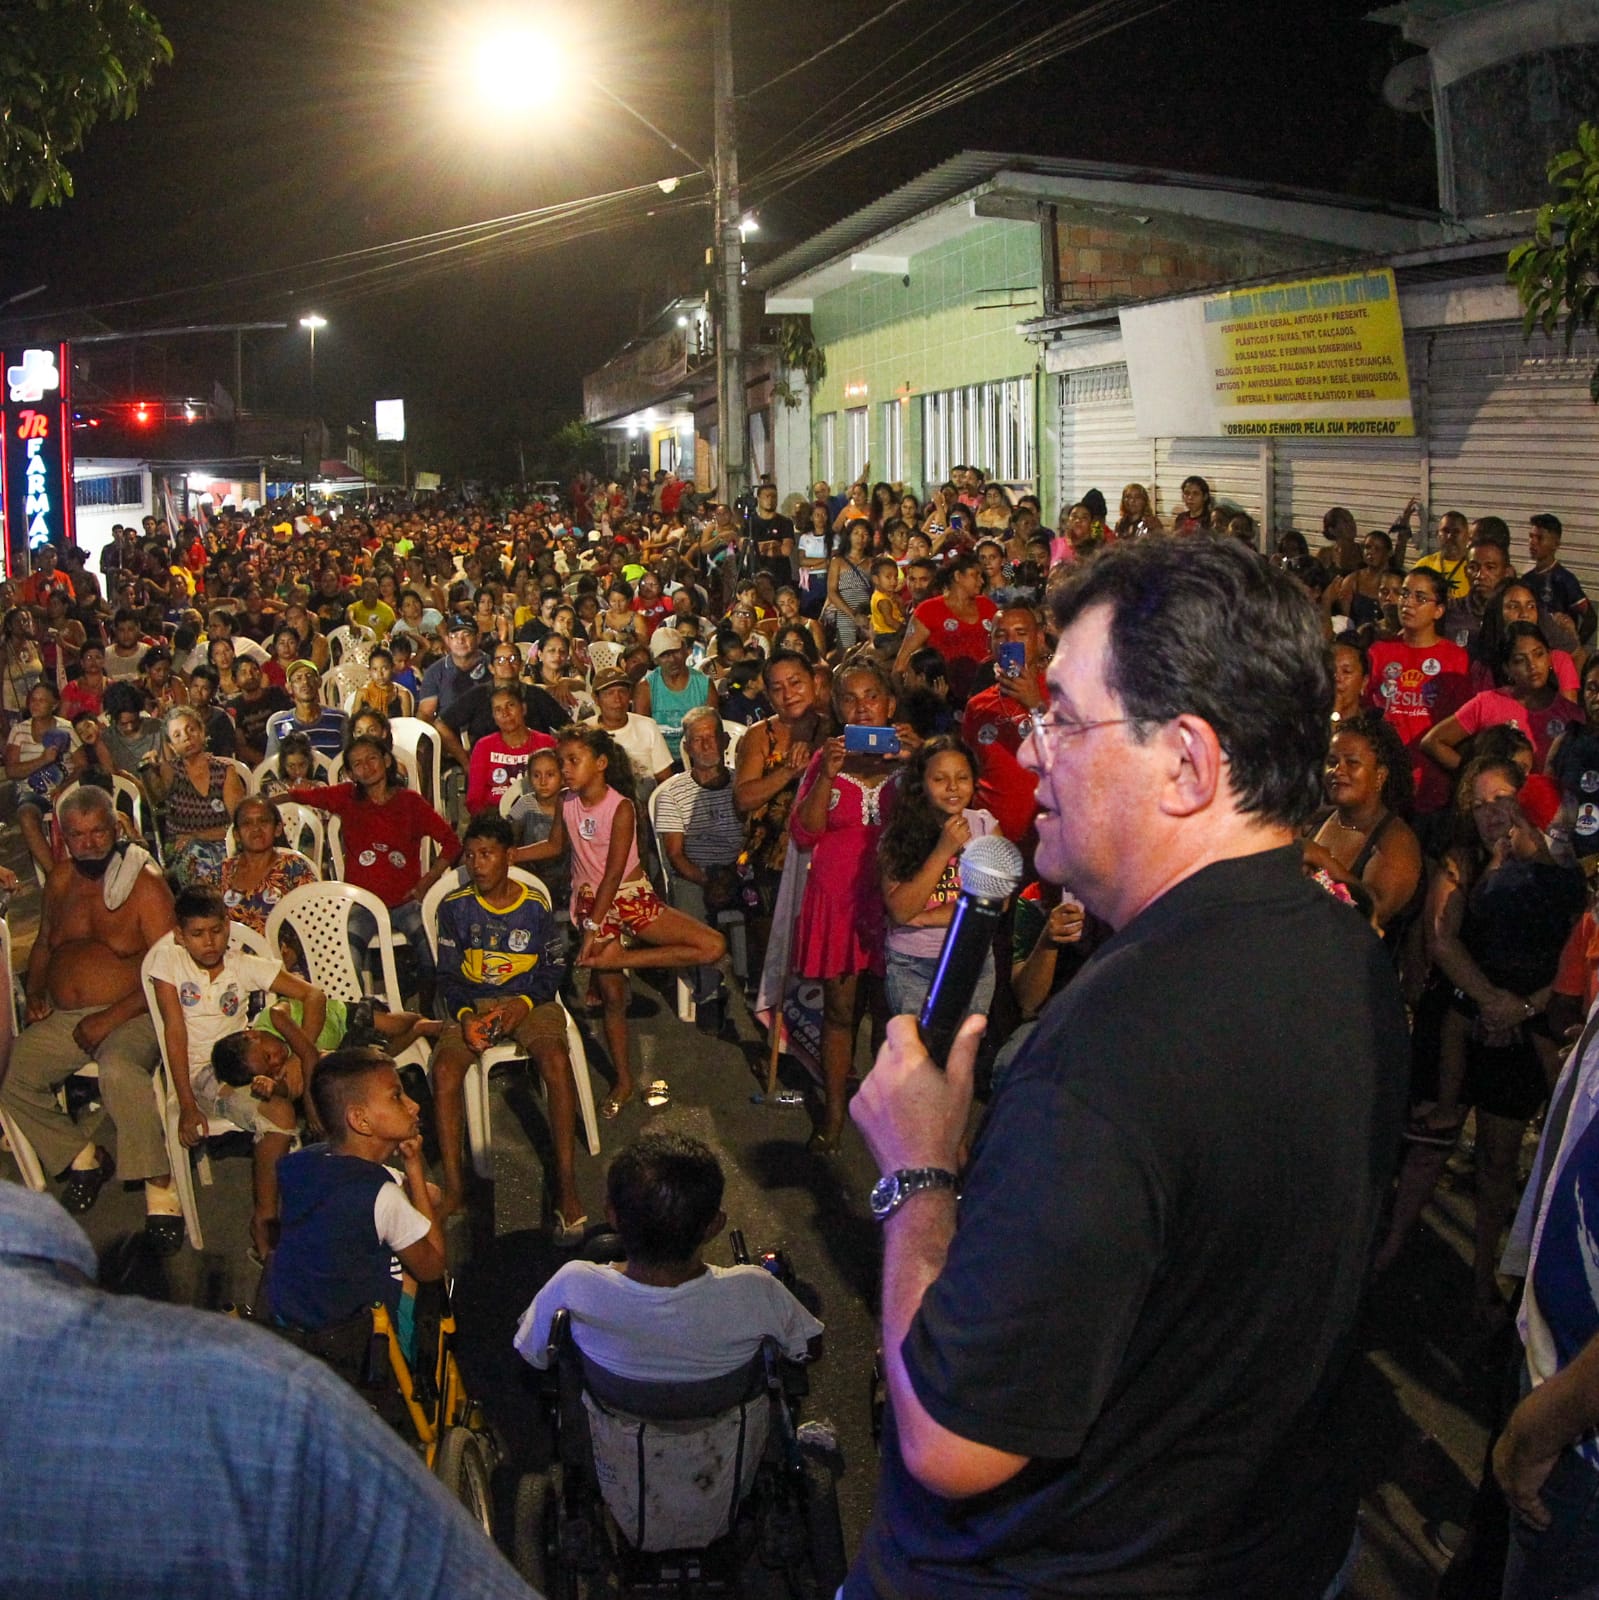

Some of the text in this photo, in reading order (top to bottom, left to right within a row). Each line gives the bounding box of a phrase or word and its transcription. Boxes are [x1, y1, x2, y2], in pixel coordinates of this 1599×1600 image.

[1317, 358, 1347, 369] ADULTOS
[1296, 376, 1320, 386] ROUPAS
[18, 408, 49, 440] JR
[1269, 422, 1303, 434] SENHOR
[1304, 421, 1326, 433] PELA
[1327, 421, 1344, 433] SUA
